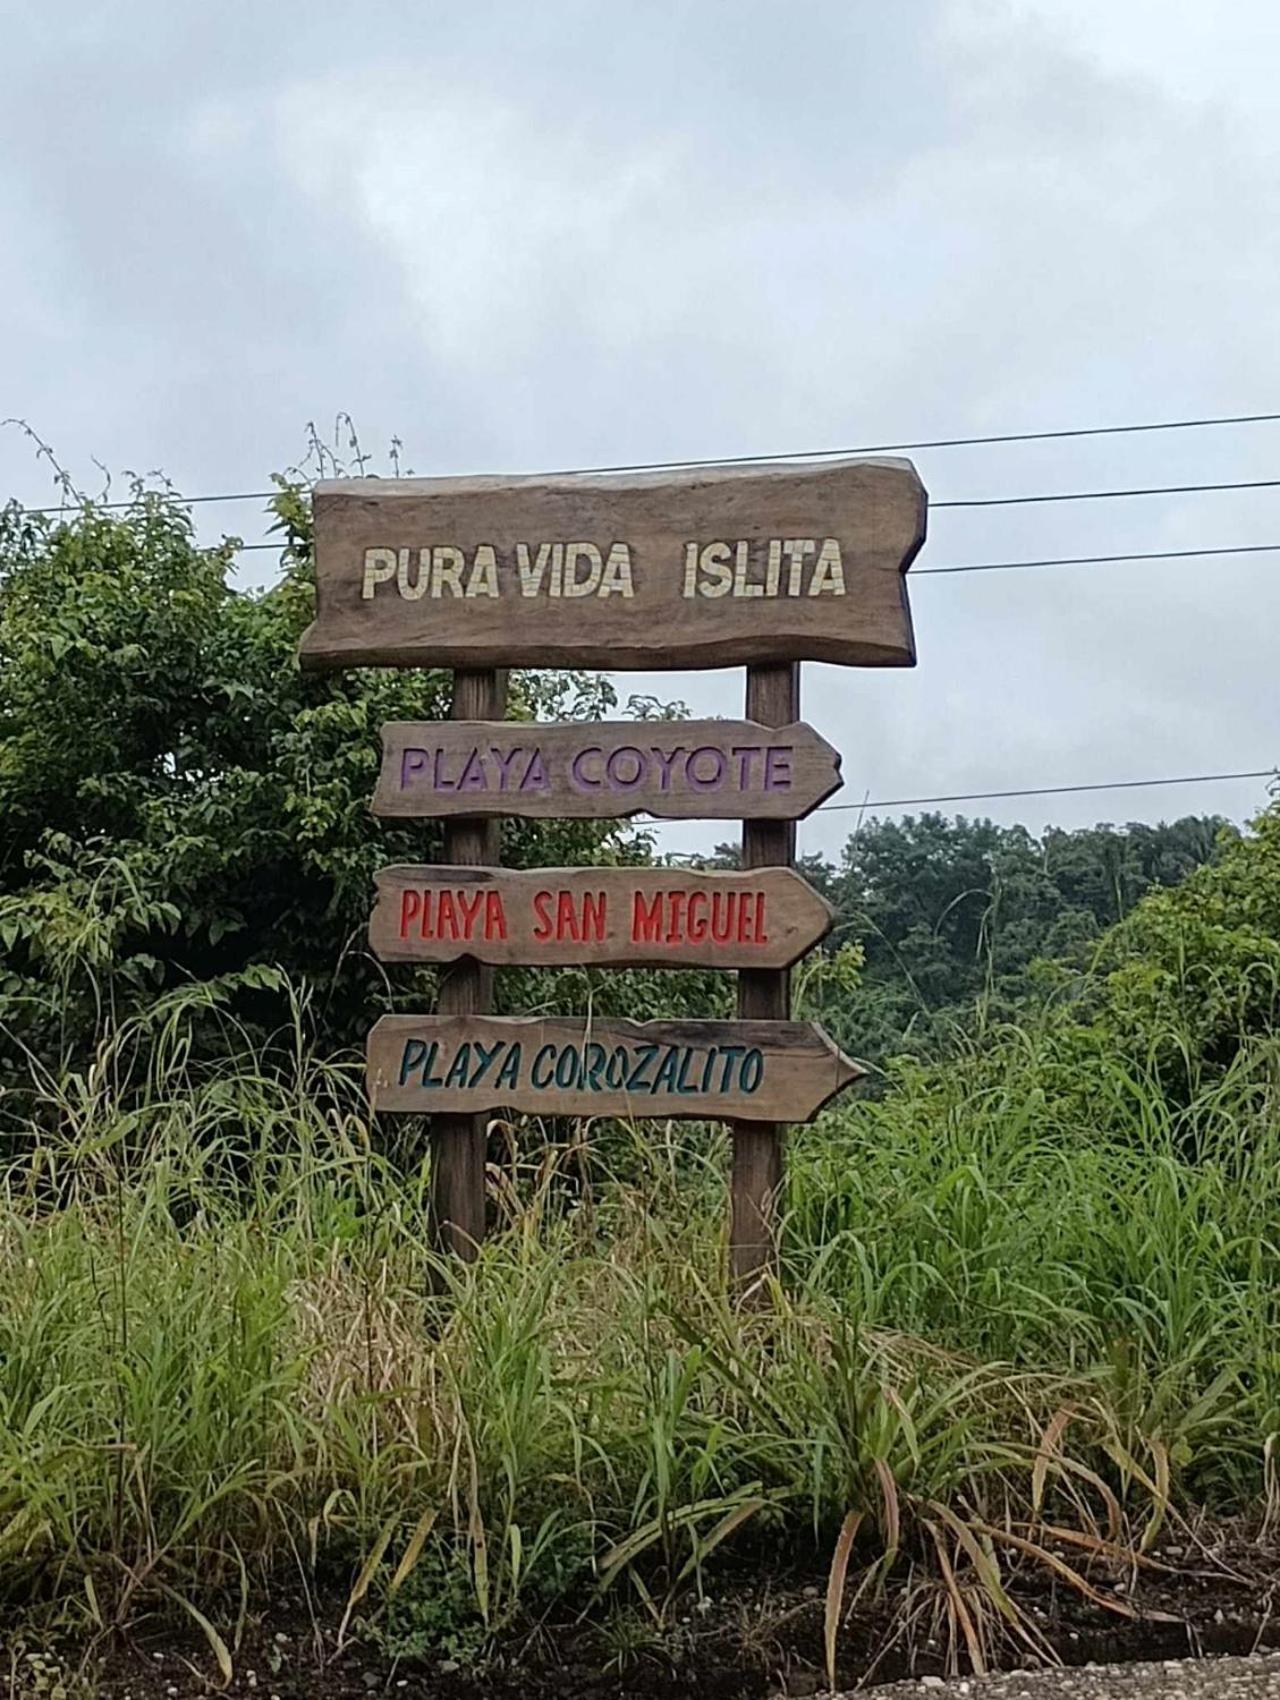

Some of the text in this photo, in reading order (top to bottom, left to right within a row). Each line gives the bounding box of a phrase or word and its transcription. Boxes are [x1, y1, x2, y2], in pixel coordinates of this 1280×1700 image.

[362, 538, 847, 601] PURA VIDA ISLITA
[401, 745, 794, 793] PLAYA COYOTE
[399, 889, 769, 944] PLAYA SAN MIGUEL
[399, 1038, 764, 1095] PLAYA COROZALITO
